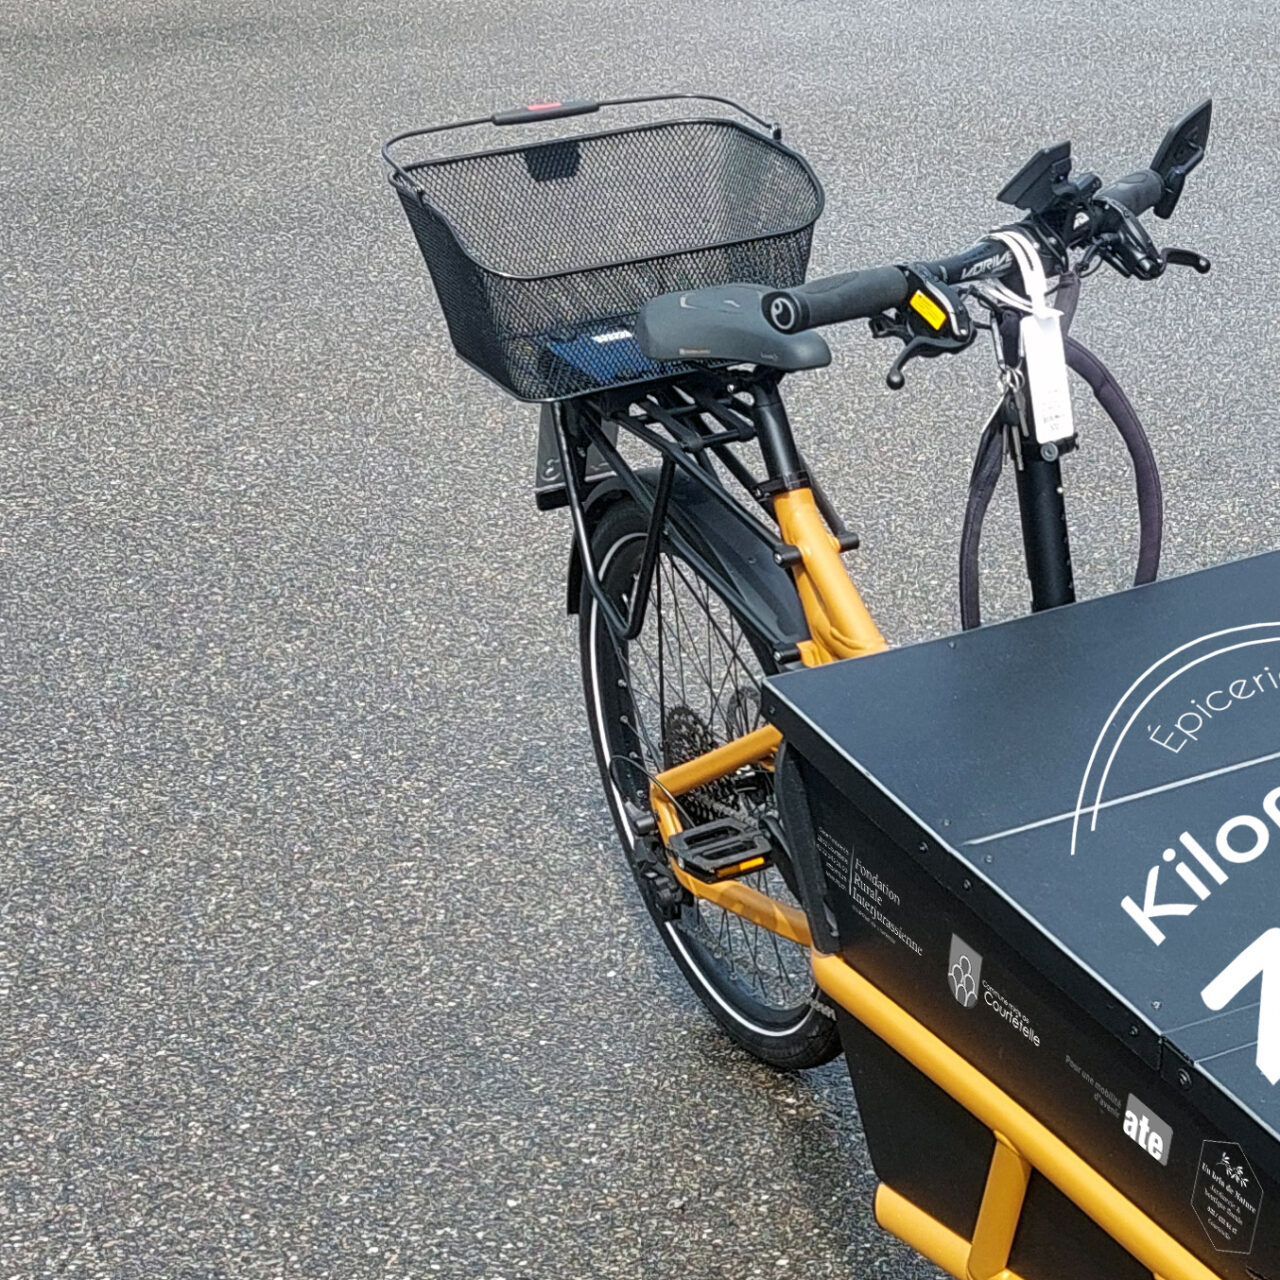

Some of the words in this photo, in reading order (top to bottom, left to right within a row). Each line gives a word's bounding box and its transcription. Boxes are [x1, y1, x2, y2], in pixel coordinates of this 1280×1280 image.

[853, 872, 883, 906] Rurale
[854, 858, 901, 906] Fondation
[852, 886, 924, 956] Interjurassienne
[984, 991, 1041, 1047] Courtételle
[1123, 1110, 1164, 1161] ate
